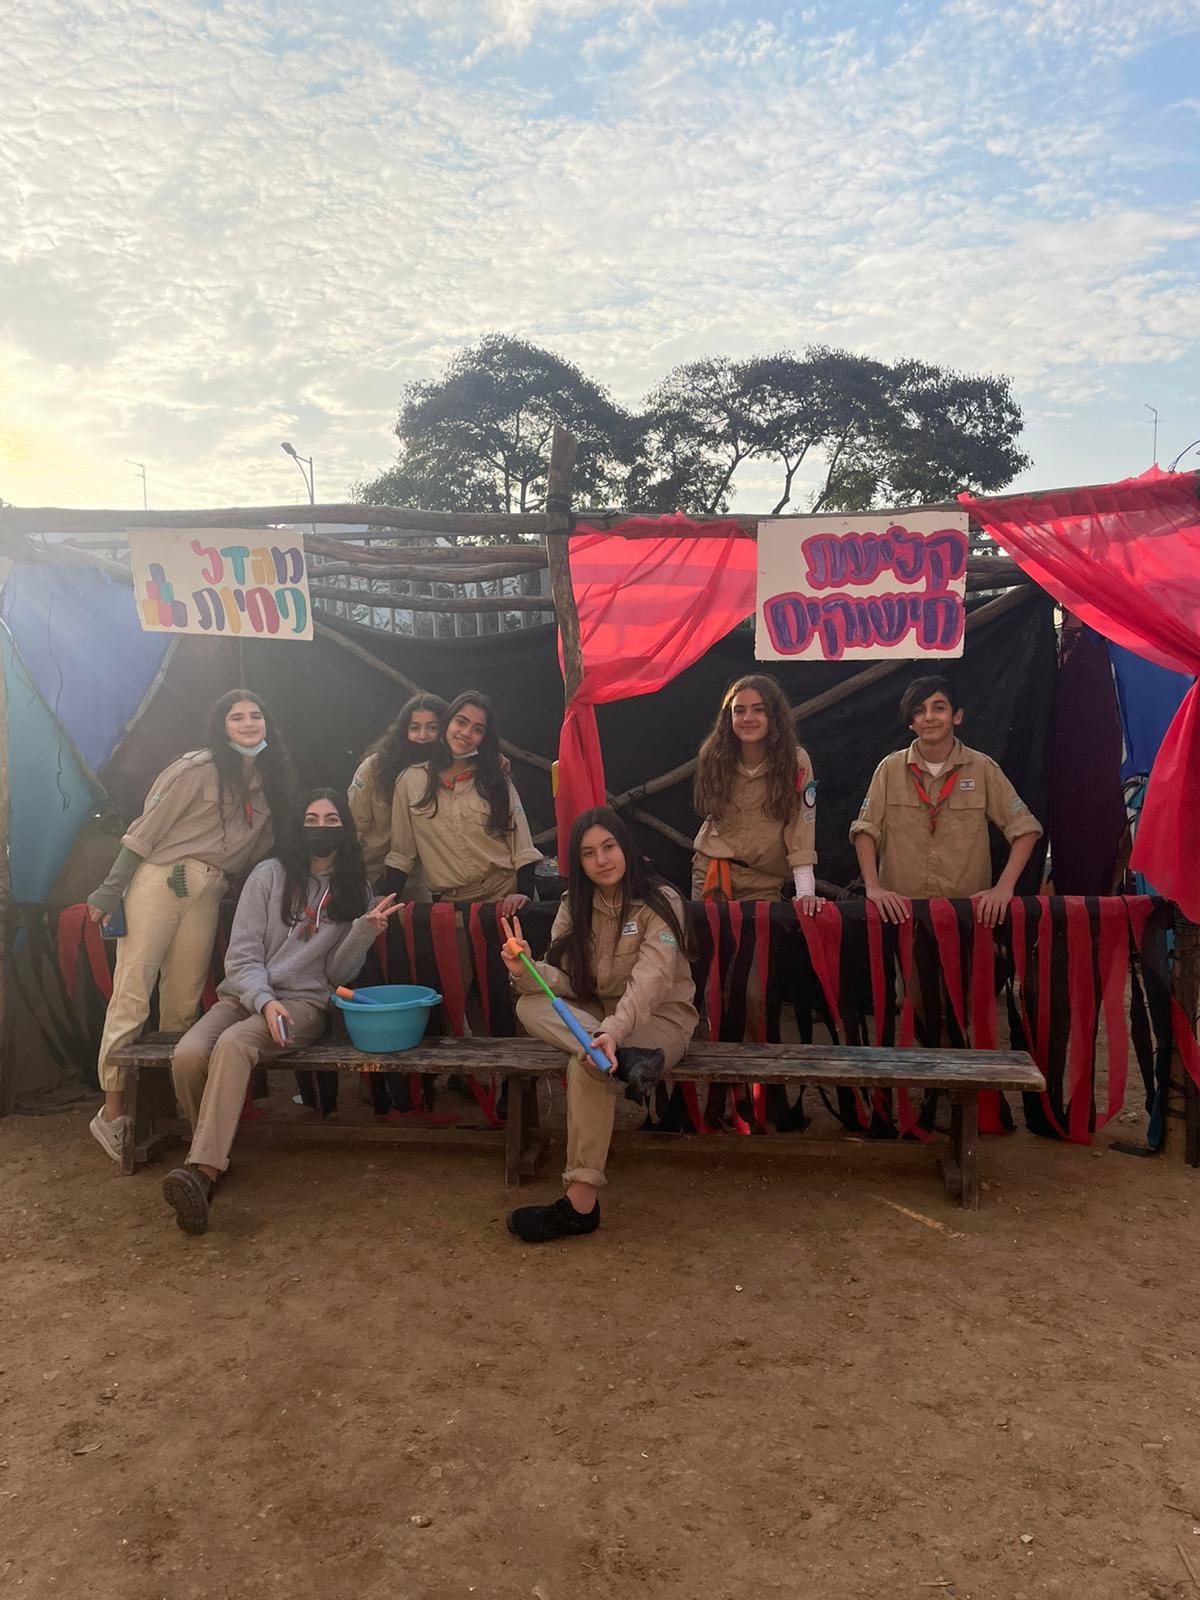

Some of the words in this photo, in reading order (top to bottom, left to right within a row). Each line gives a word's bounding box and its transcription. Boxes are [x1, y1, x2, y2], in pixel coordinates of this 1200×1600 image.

[191, 539, 304, 585] מגדל
[801, 525, 968, 593] קליעת
[192, 587, 307, 634] פחיות
[763, 591, 964, 660] חישוקים
